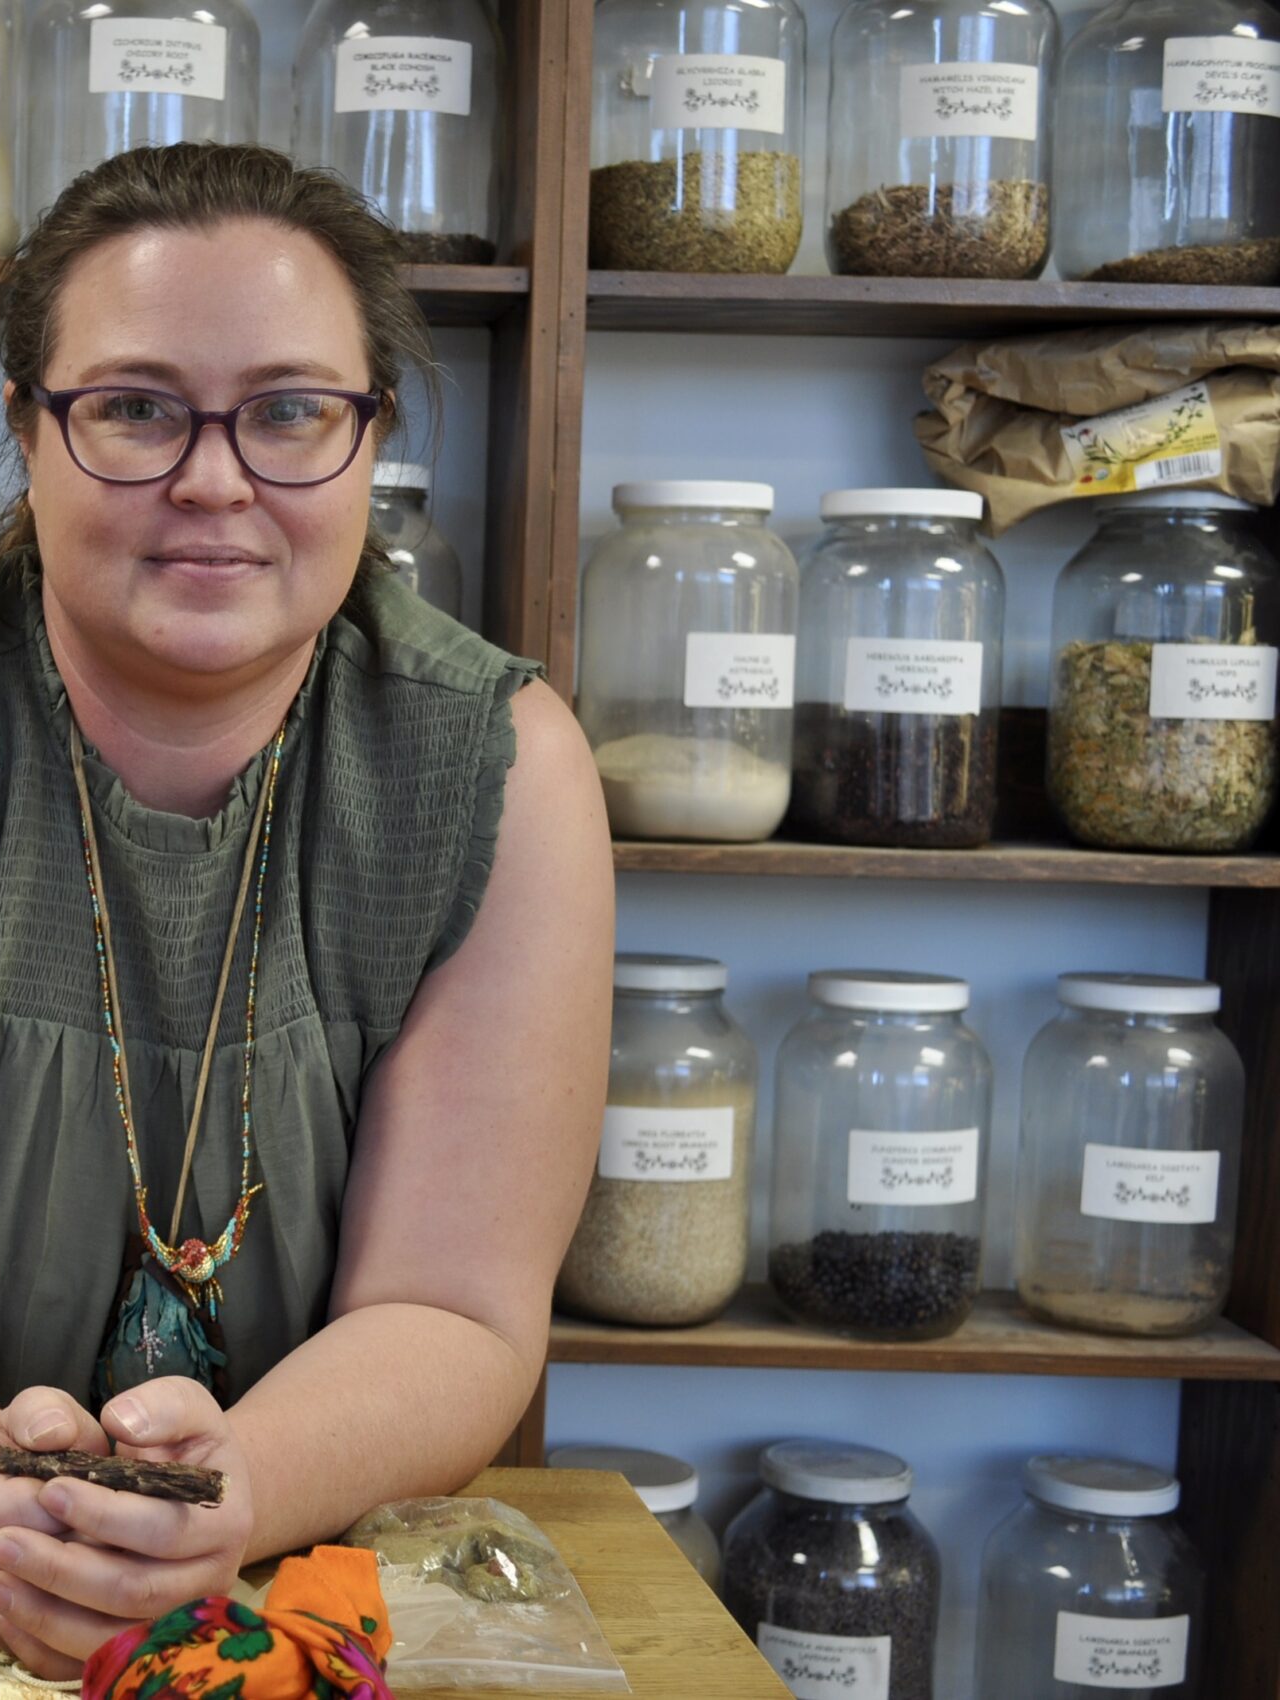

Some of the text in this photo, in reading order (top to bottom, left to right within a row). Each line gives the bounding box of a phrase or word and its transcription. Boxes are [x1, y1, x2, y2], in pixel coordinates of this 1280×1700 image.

[125, 49, 188, 59] CHICORY ROOT
[371, 63, 436, 72] BLACK COHOSH
[1240, 72, 1263, 80] CLAW
[932, 86, 963, 95] WITCH
[966, 86, 993, 94] HAZEL
[1215, 669, 1237, 678] HOPS
[1145, 1173, 1165, 1182] KELP
